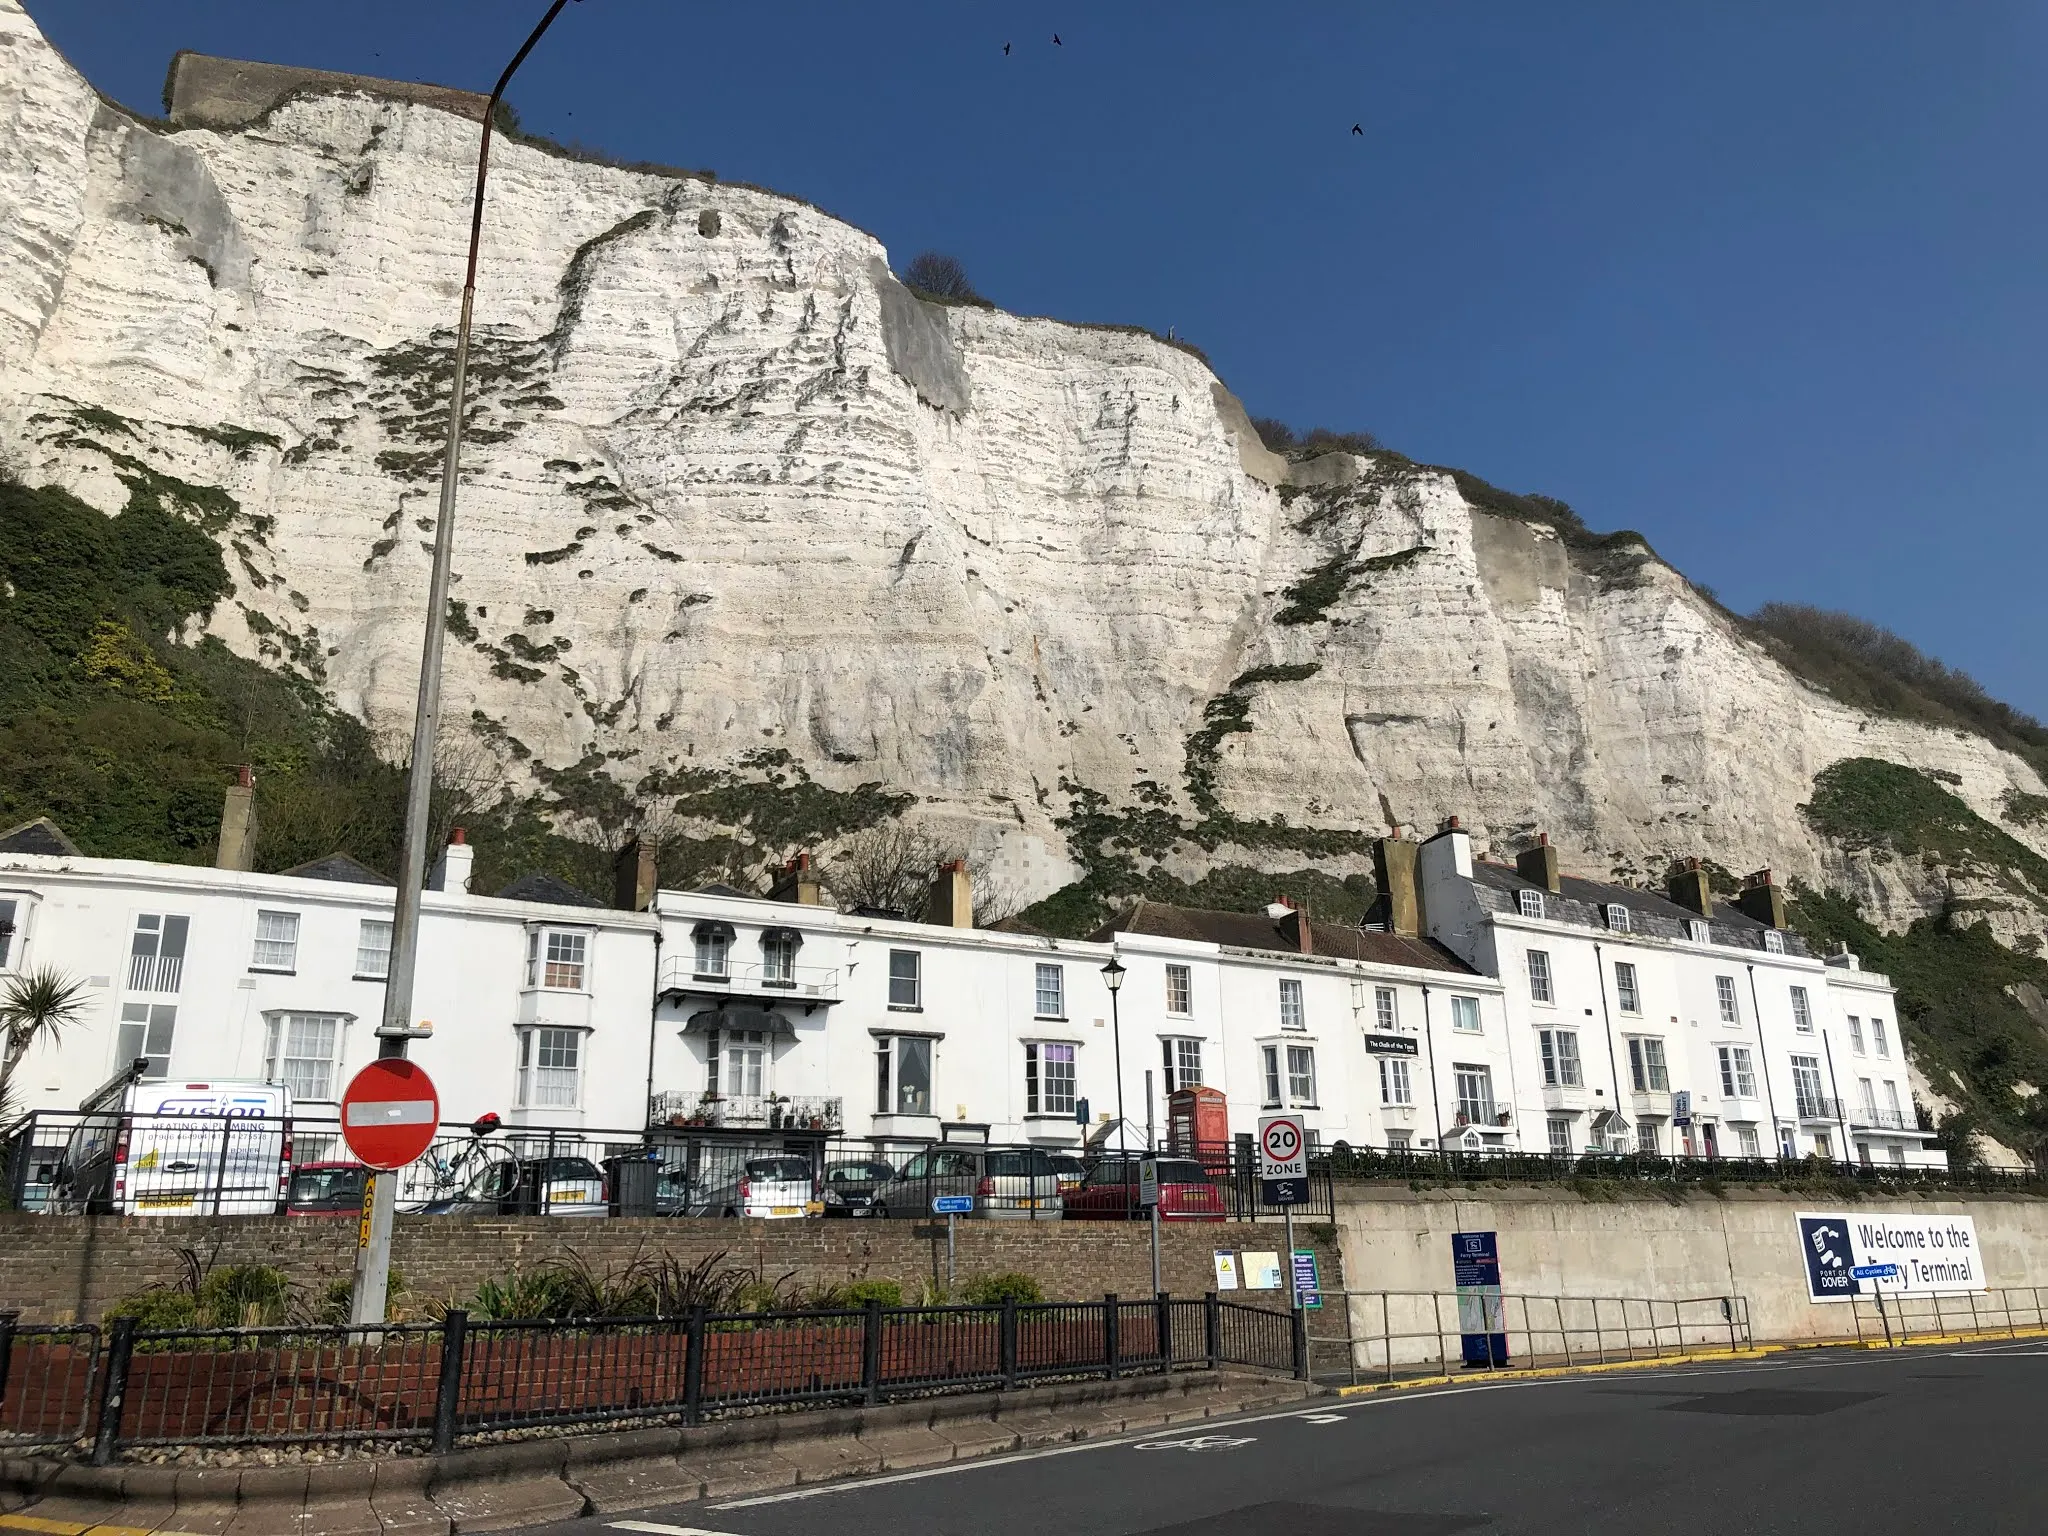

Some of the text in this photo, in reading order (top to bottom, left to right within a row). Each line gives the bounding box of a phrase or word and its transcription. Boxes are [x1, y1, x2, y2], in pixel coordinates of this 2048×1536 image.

[1369, 1040, 1378, 1048] The
[151, 1122, 266, 1132] HEATING & PLMBING
[1269, 1131, 1296, 1149] 20
[1266, 1163, 1302, 1175] ZONE
[1858, 1223, 1970, 1249] Welcome to the
[1838, 1269, 1846, 1277] OF
[1910, 1256, 1973, 1282] Terminal
[1821, 1276, 1849, 1288] DOVER
